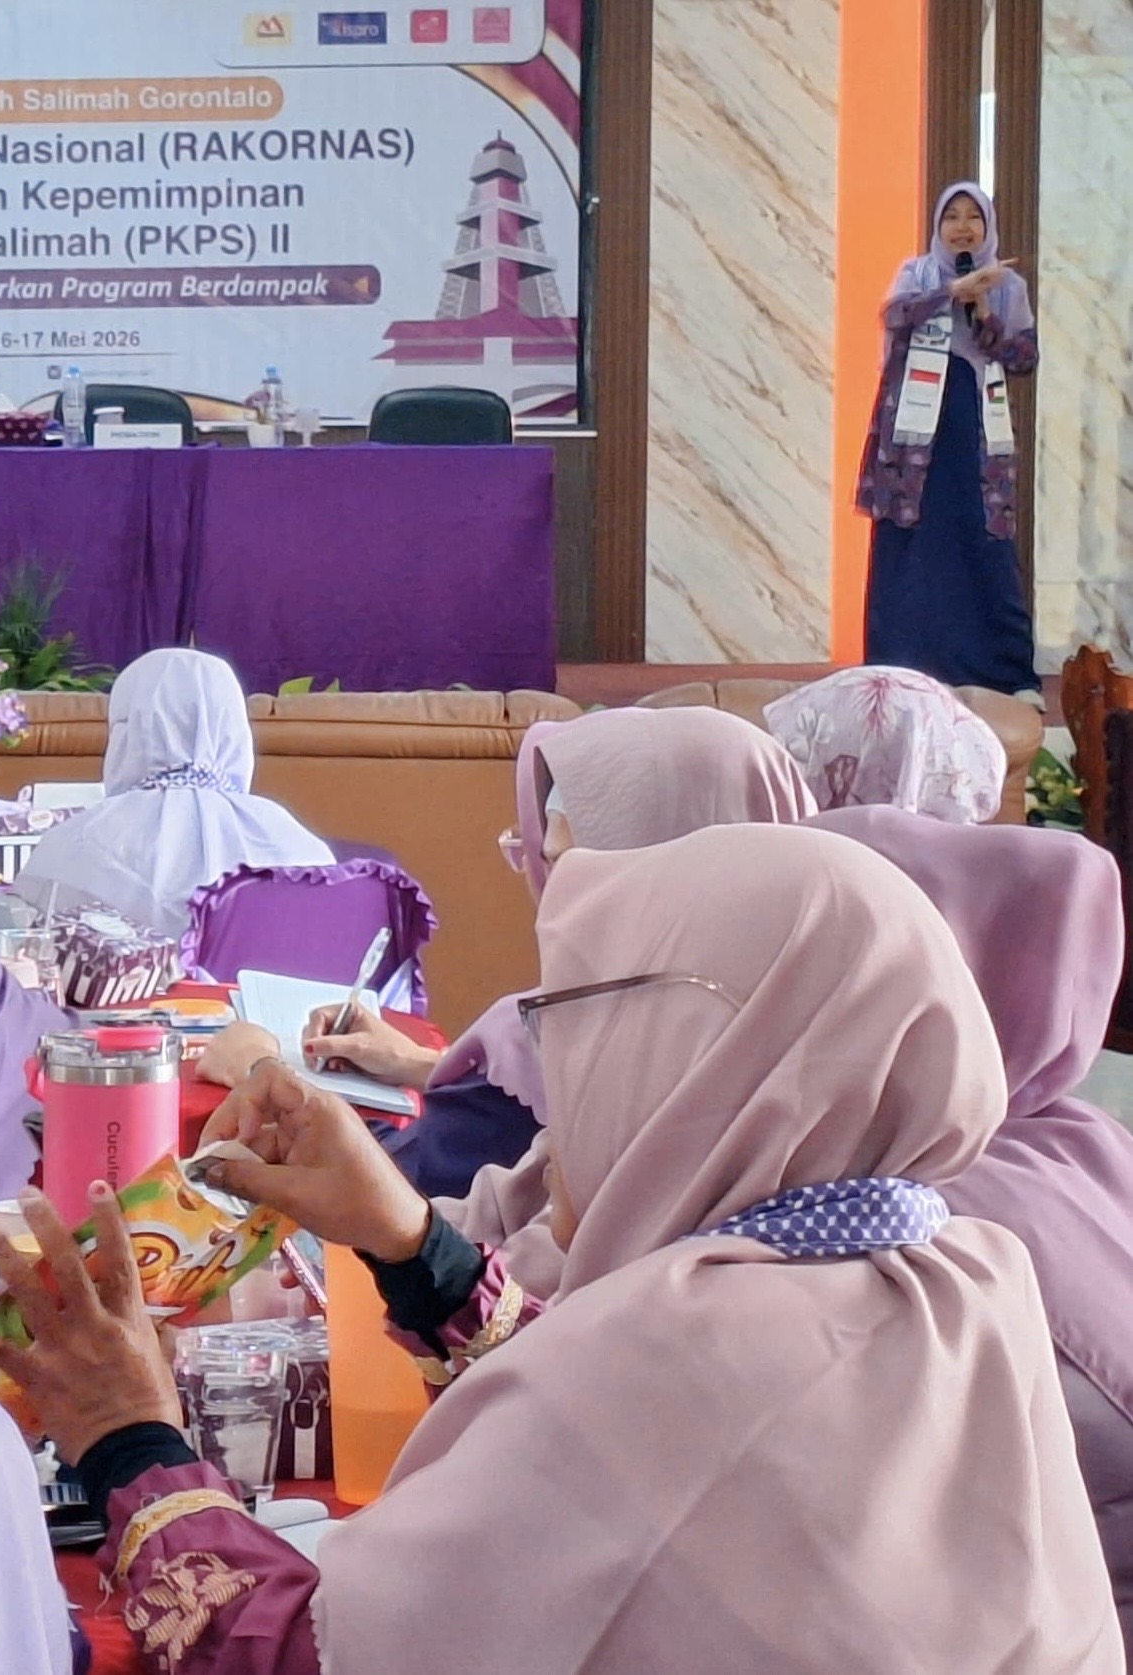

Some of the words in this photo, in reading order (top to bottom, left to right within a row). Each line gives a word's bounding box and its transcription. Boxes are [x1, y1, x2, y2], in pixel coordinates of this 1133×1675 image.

[22, 86, 130, 112] Salimah
[139, 84, 274, 110] Gorontalo
[159, 128, 415, 170] (RAKORNAS)
[22, 178, 305, 218] Kepemimpinan
[124, 223, 257, 264] (PKPS)
[270, 223, 290, 255] II
[61, 276, 173, 303] Program
[180, 273, 329, 301] Berdampak
[51, 331, 87, 348] Mei
[94, 330, 141, 348] 2026
